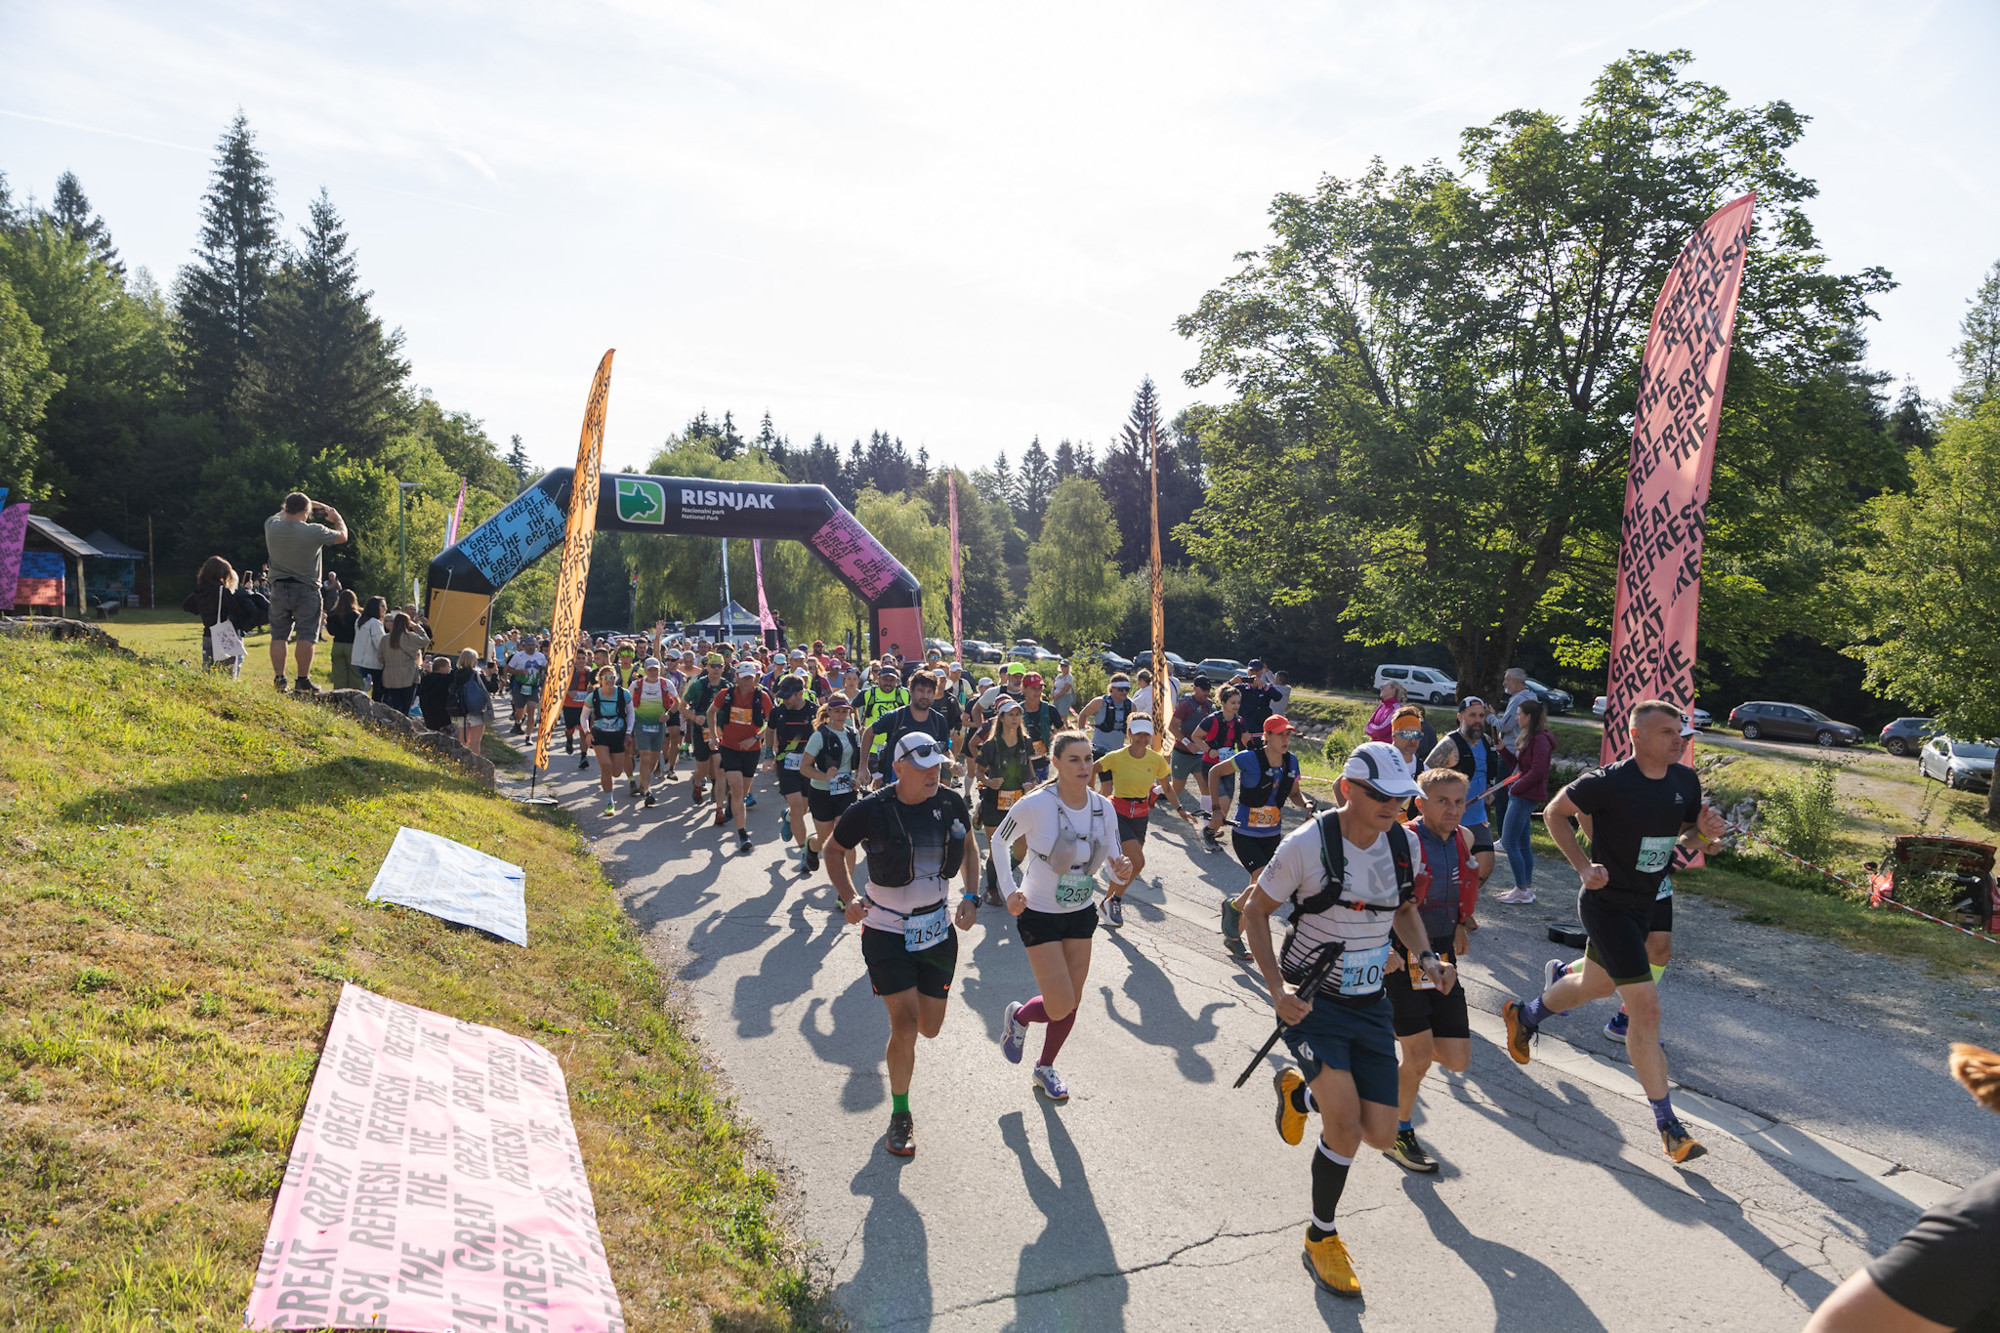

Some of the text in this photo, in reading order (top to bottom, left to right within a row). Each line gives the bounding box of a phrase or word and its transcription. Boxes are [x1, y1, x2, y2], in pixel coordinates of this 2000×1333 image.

[1683, 296, 1721, 355] THE
[1667, 320, 1726, 411] GREAT
[1636, 367, 1670, 424] THE
[1631, 374, 1715, 494] REFRESH
[1669, 412, 1708, 471] THE
[505, 496, 535, 523] GREAT
[526, 511, 546, 532] THE
[681, 489, 775, 511] RISNJAK
[469, 522, 501, 551] GREAT
[500, 532, 521, 552] THE
[525, 517, 556, 547] GREAT
[824, 531, 854, 557] GREAT
[845, 538, 864, 555] THE
[1621, 490, 1672, 572] GREAT
[490, 545, 521, 574] GREAT
[853, 559, 882, 583] GREAT
[866, 558, 887, 576] THE
[1621, 581, 1658, 634] THE
[1612, 605, 1664, 683] GREAT
[1258, 814, 1274, 824] 23
[1063, 888, 1091, 902] 253
[914, 920, 942, 945] 182
[382, 1000, 420, 1063] REFRESH
[420, 1027, 450, 1055] THE
[337, 1034, 376, 1088] GREAT
[488, 1041, 520, 1106] REFRESH
[520, 1055, 549, 1088] THE
[366, 1072, 411, 1146] REFRESH
[415, 1075, 448, 1109] THE
[453, 1066, 485, 1113] GREAT
[320, 1090, 365, 1151] GREAT
[409, 1127, 447, 1157] THE
[529, 1119, 565, 1151] THE
[454, 1125, 491, 1180] GREAT
[491, 1119, 533, 1190] REFRESH
[300, 1153, 352, 1226] GREAT
[348, 1160, 401, 1250] REFRESH
[405, 1170, 448, 1209] THE
[537, 1184, 577, 1222] THE
[452, 1193, 496, 1272] GREAT
[271, 1238, 339, 1330] GREAT
[397, 1242, 446, 1300] THE
[549, 1242, 595, 1296] THE
